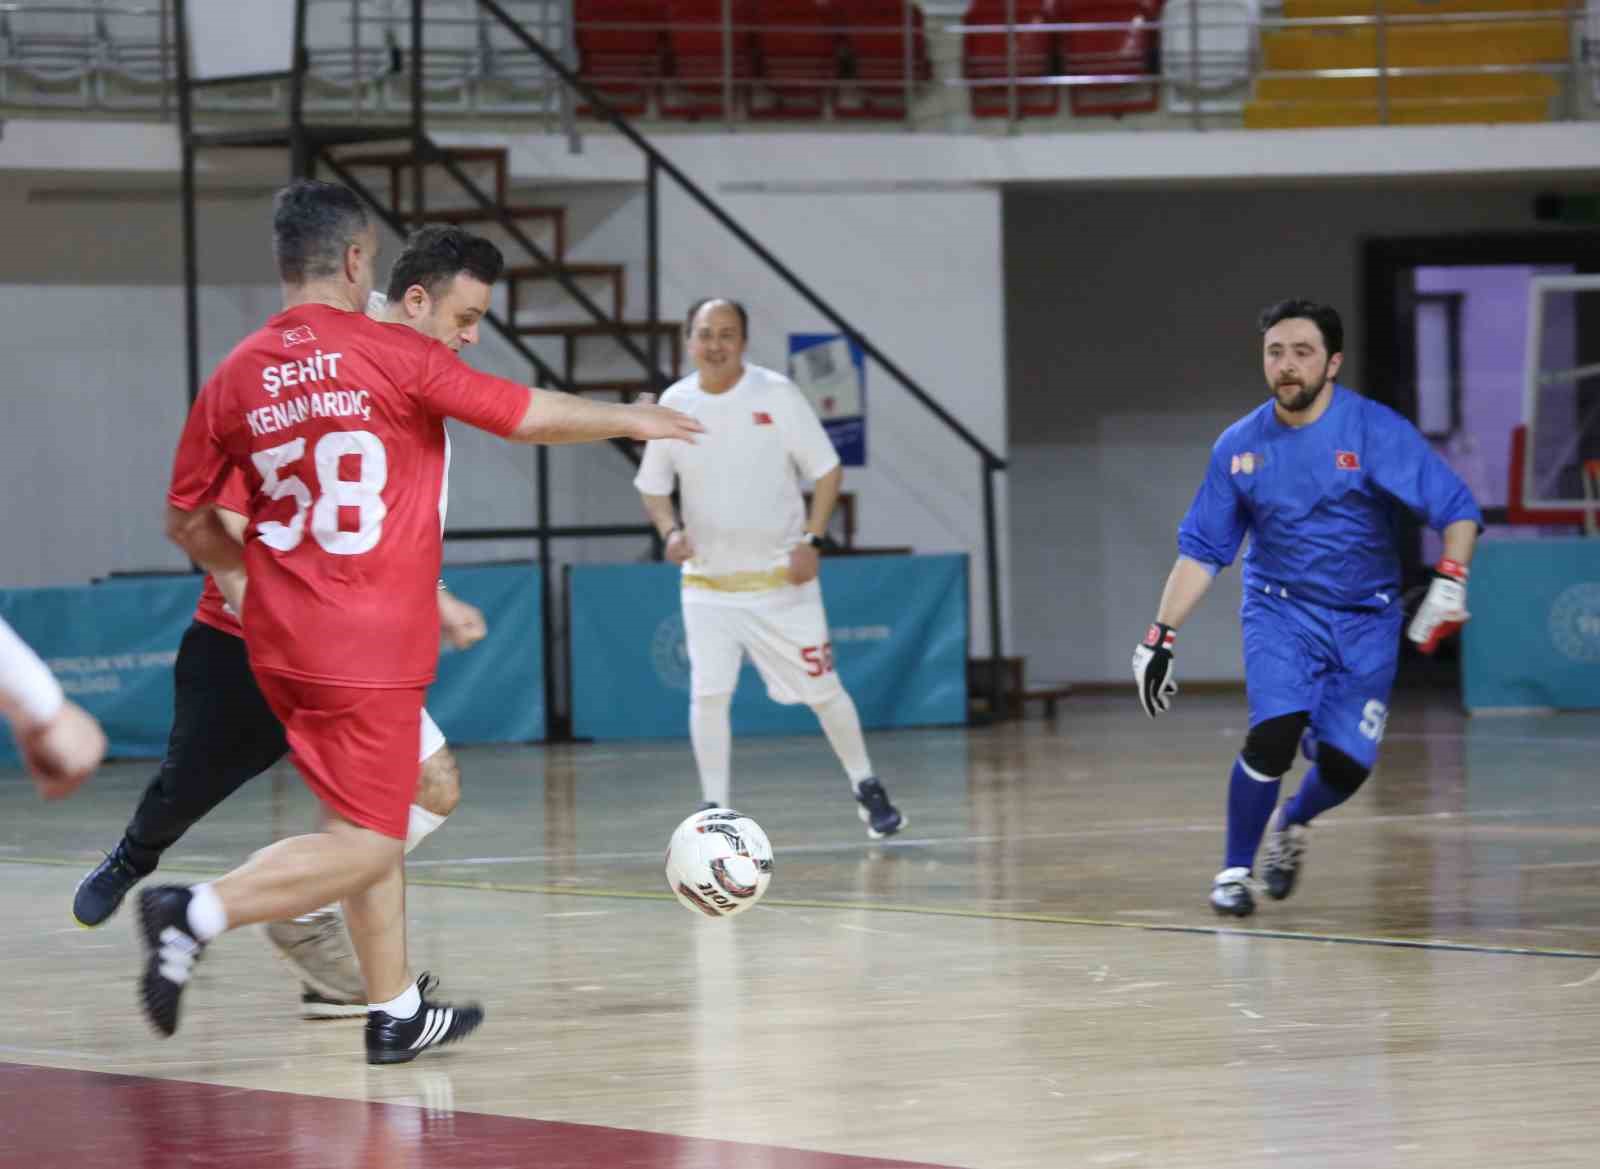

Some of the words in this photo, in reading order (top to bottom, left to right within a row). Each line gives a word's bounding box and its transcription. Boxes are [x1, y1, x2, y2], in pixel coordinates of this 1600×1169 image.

[262, 350, 342, 397] ŞEHİT
[246, 396, 309, 436] KENAN
[311, 390, 371, 421] ARDIÇ
[251, 430, 388, 556] 58
